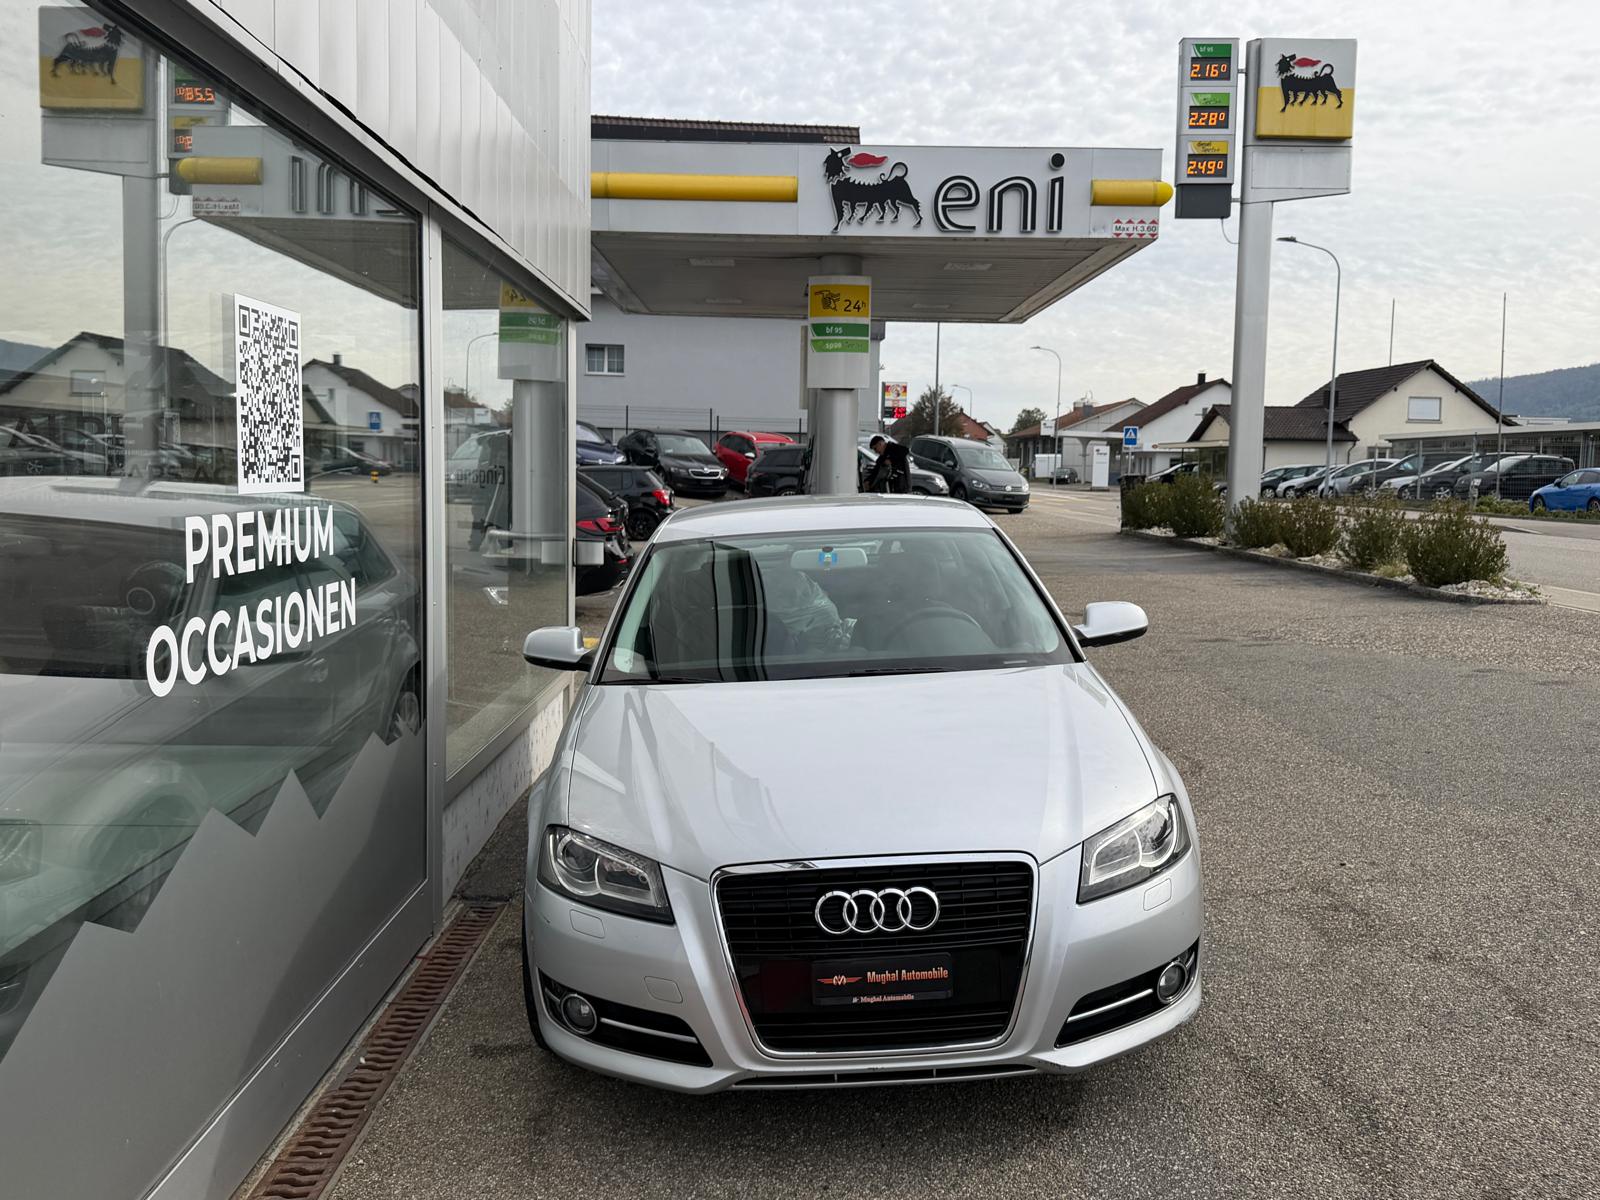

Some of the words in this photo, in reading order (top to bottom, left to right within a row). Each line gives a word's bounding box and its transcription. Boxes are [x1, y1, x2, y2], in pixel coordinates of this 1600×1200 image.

[932, 152, 1065, 233] eni
[185, 504, 334, 584] PREMIUM
[146, 577, 356, 698] OCCASIONEN
[867, 969, 899, 984] Mughal
[901, 966, 949, 980] Automobile
